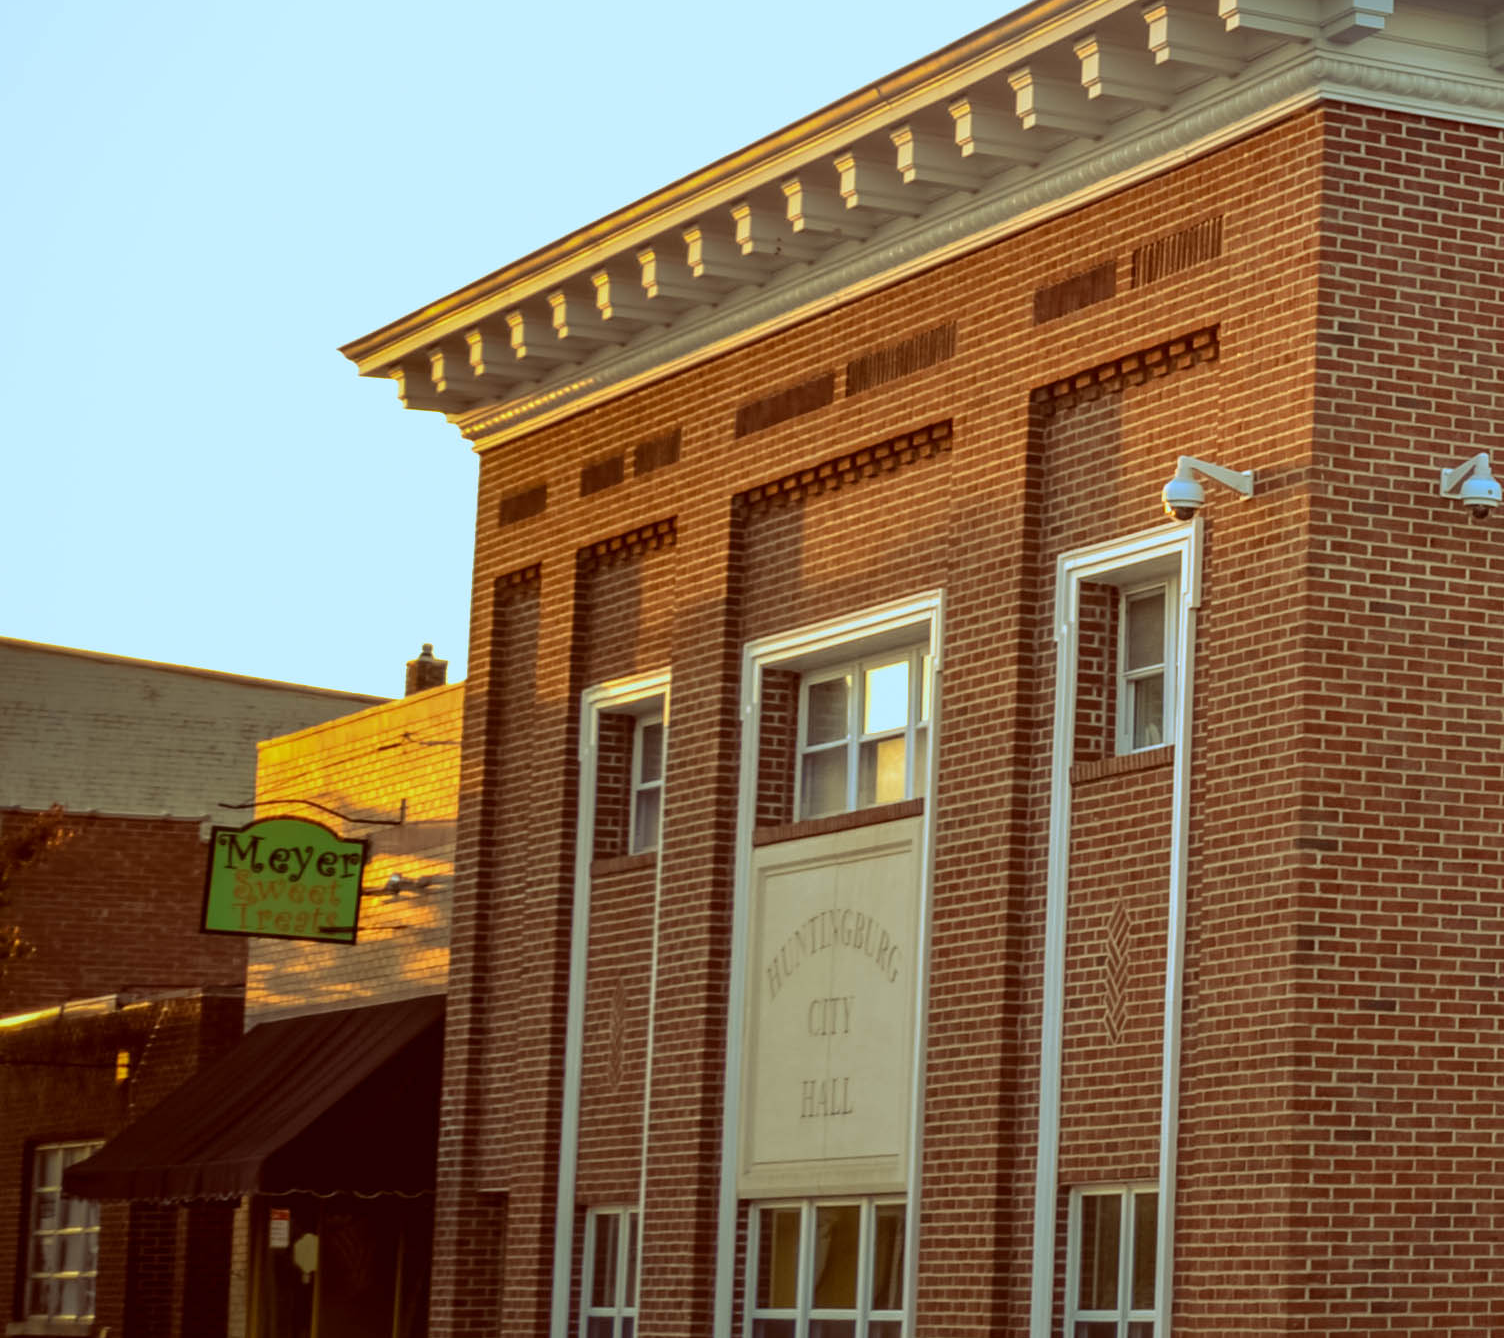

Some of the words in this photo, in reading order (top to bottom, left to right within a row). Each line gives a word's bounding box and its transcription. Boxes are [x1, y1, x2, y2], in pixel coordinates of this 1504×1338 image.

[217, 834, 361, 882] Meyer
[232, 868, 343, 906] Sweet
[232, 903, 339, 933] Treats
[765, 908, 902, 1003] HUNTINGBURG
[808, 996, 855, 1037] CITY
[800, 1077, 853, 1119] HALL
